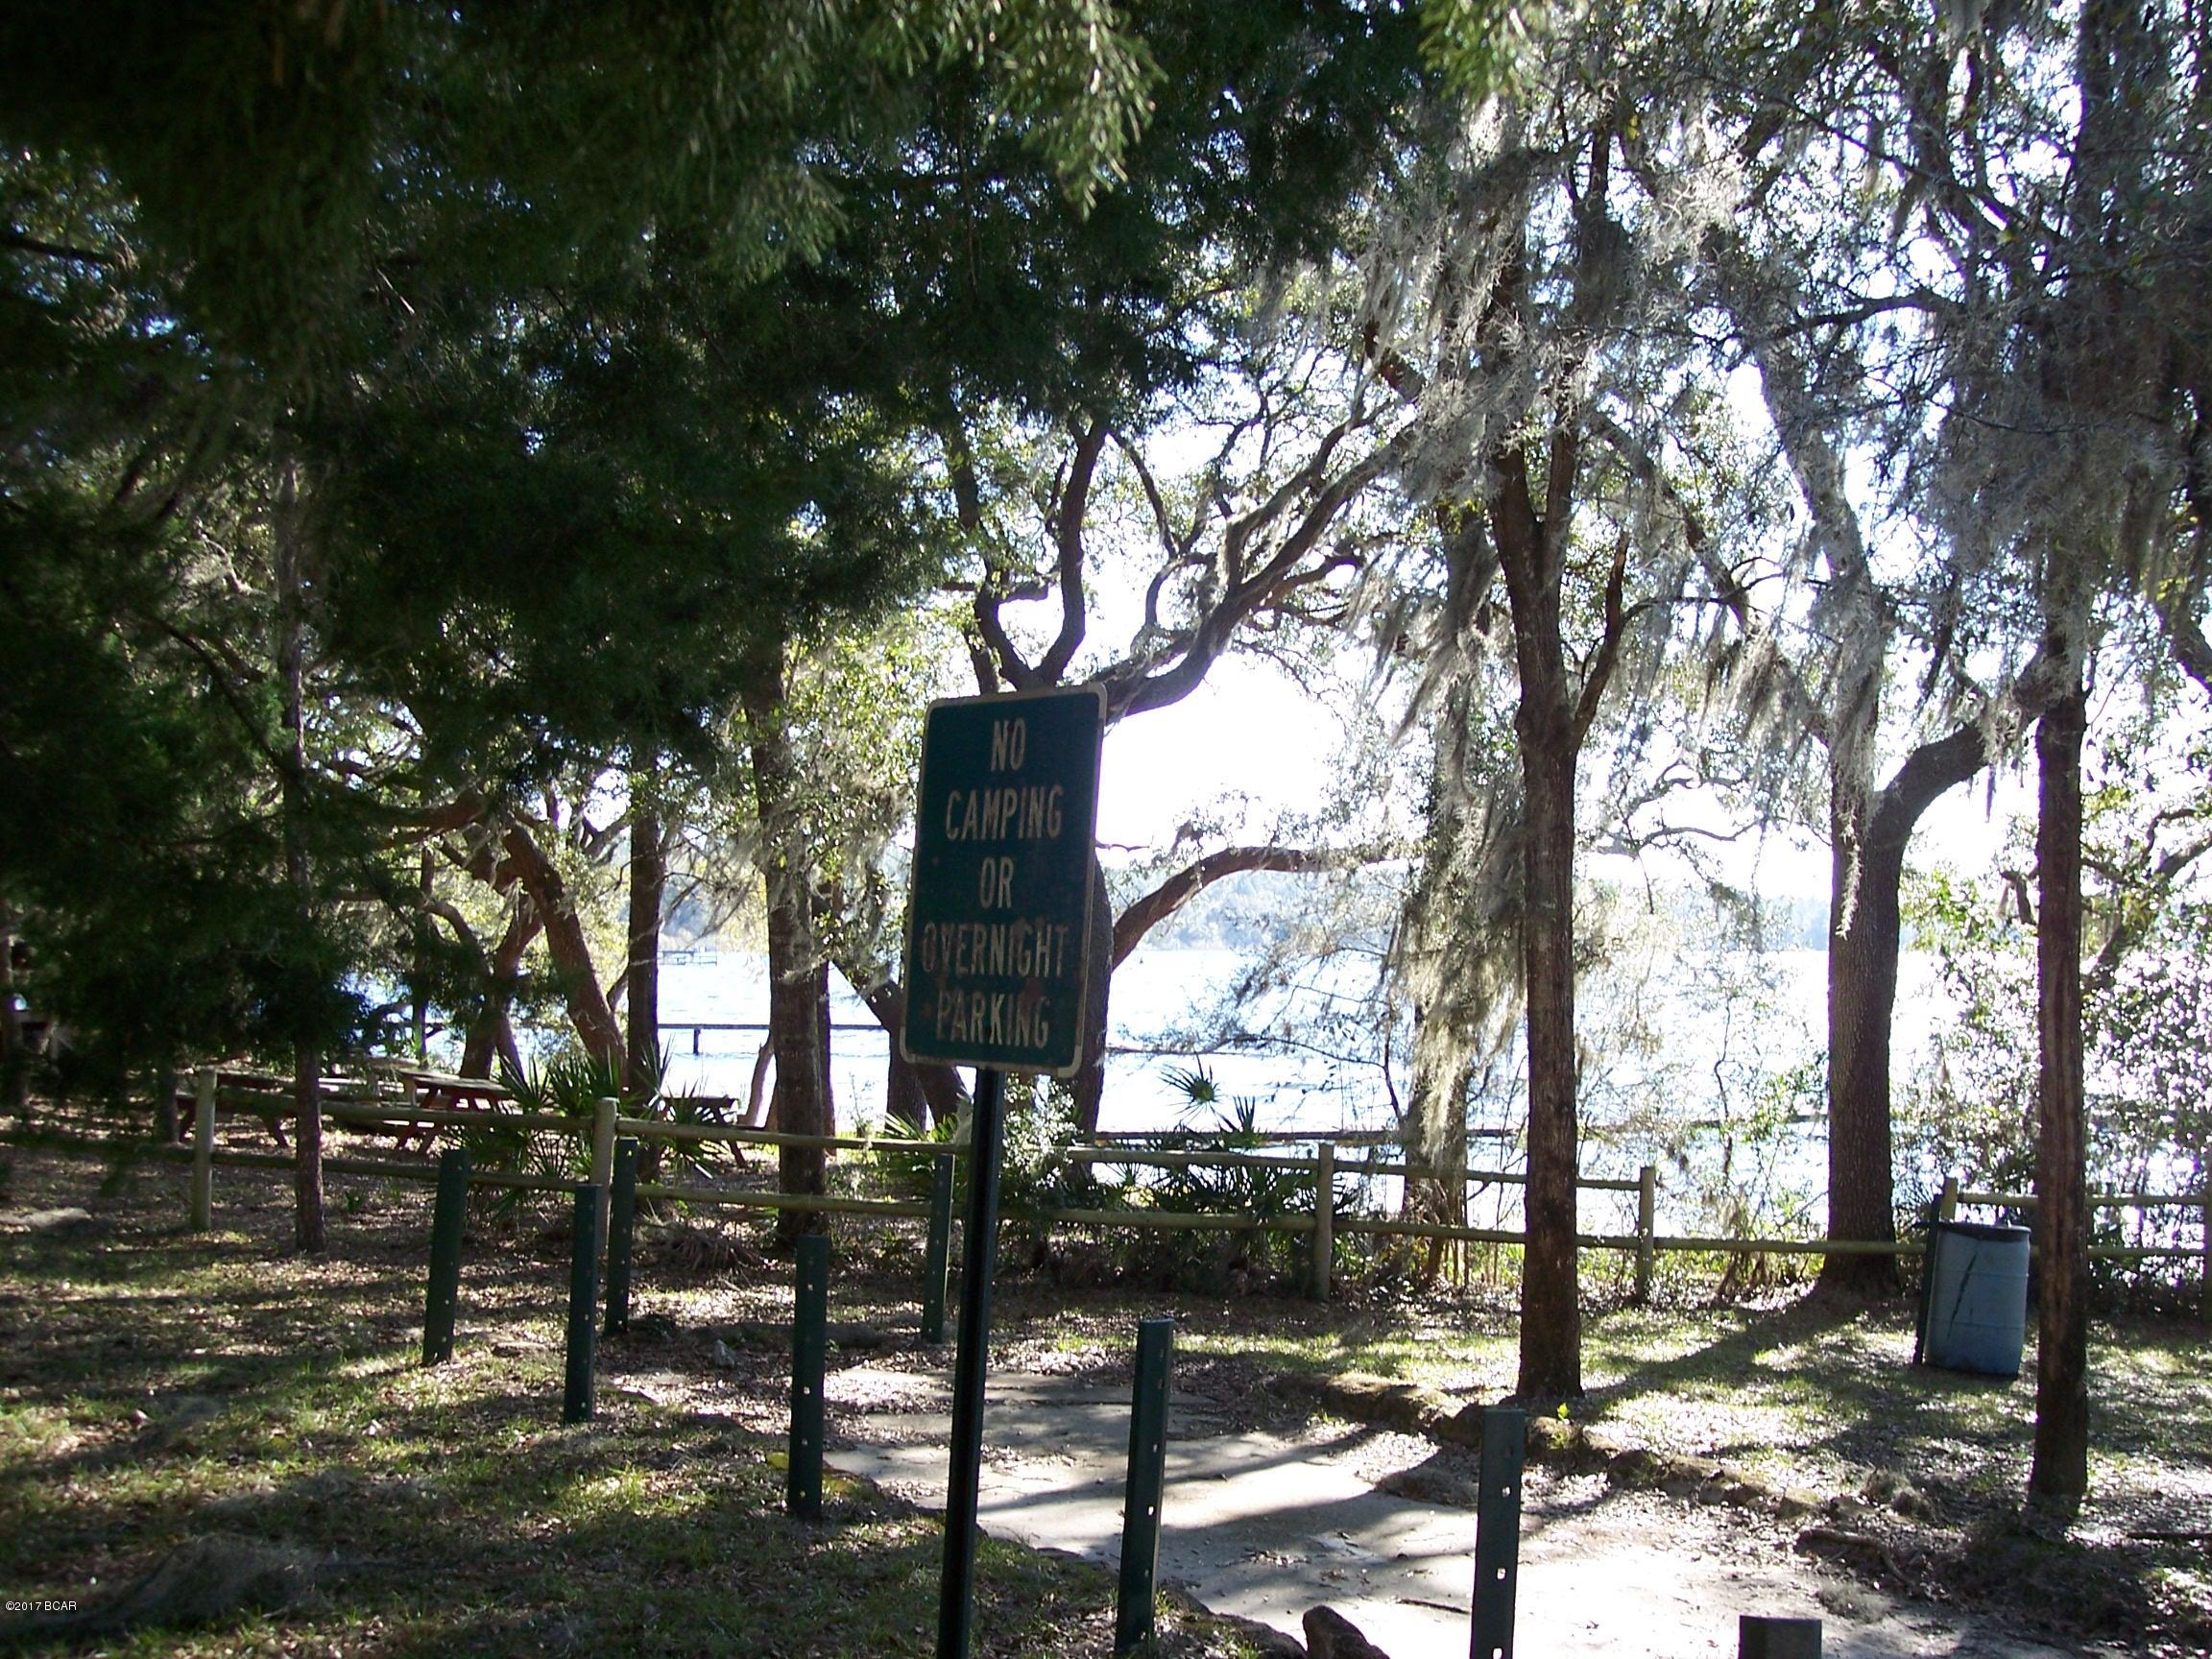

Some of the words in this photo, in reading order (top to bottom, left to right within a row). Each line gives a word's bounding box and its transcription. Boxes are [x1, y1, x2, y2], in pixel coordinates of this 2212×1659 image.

[990, 716, 1026, 771] NO
[945, 784, 1064, 842] CAMPING
[979, 855, 1015, 909] OR
[921, 921, 1070, 979] OVERNIGHT
[935, 989, 1051, 1049] PARKING
